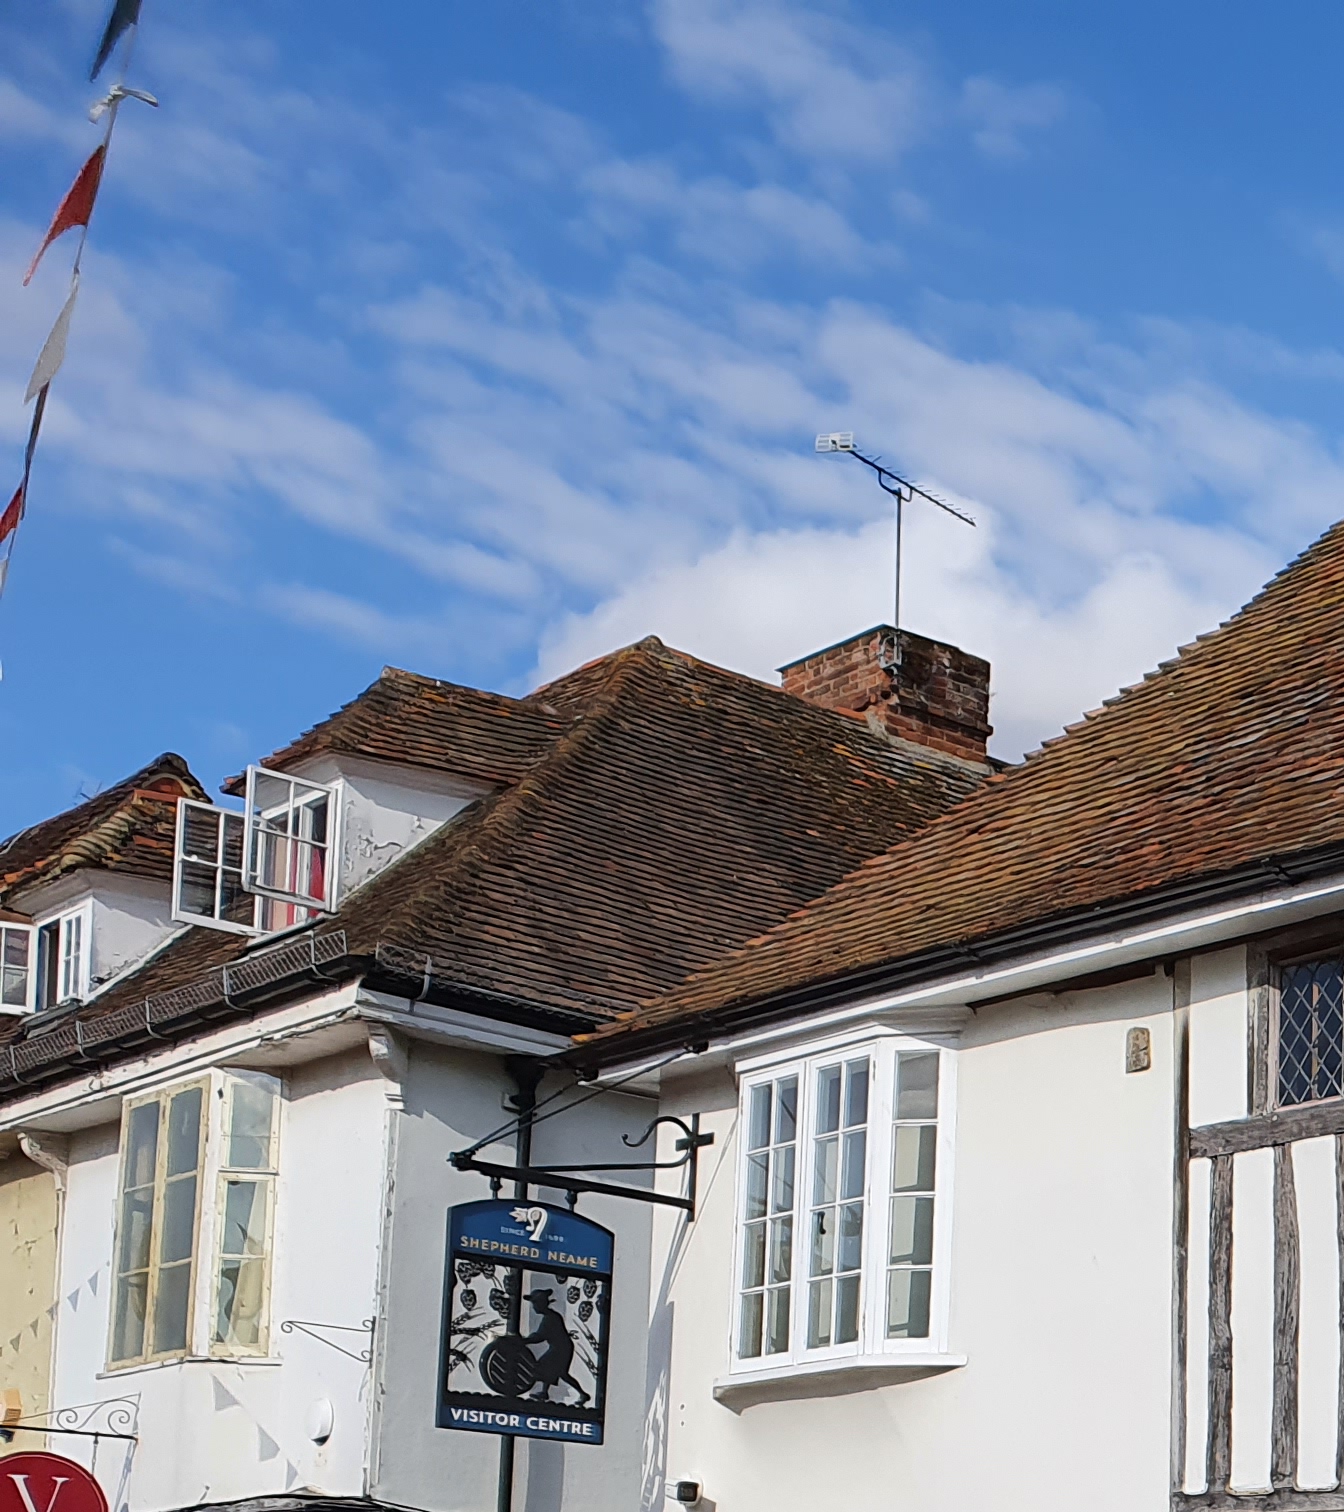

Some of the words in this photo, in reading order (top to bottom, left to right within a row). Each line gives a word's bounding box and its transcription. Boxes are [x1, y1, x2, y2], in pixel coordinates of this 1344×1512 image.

[460, 1236, 540, 1259] SHEPHERD
[547, 1250, 598, 1268] NEAME
[451, 1408, 520, 1428] VISITOR
[526, 1417, 593, 1436] CENTRE
